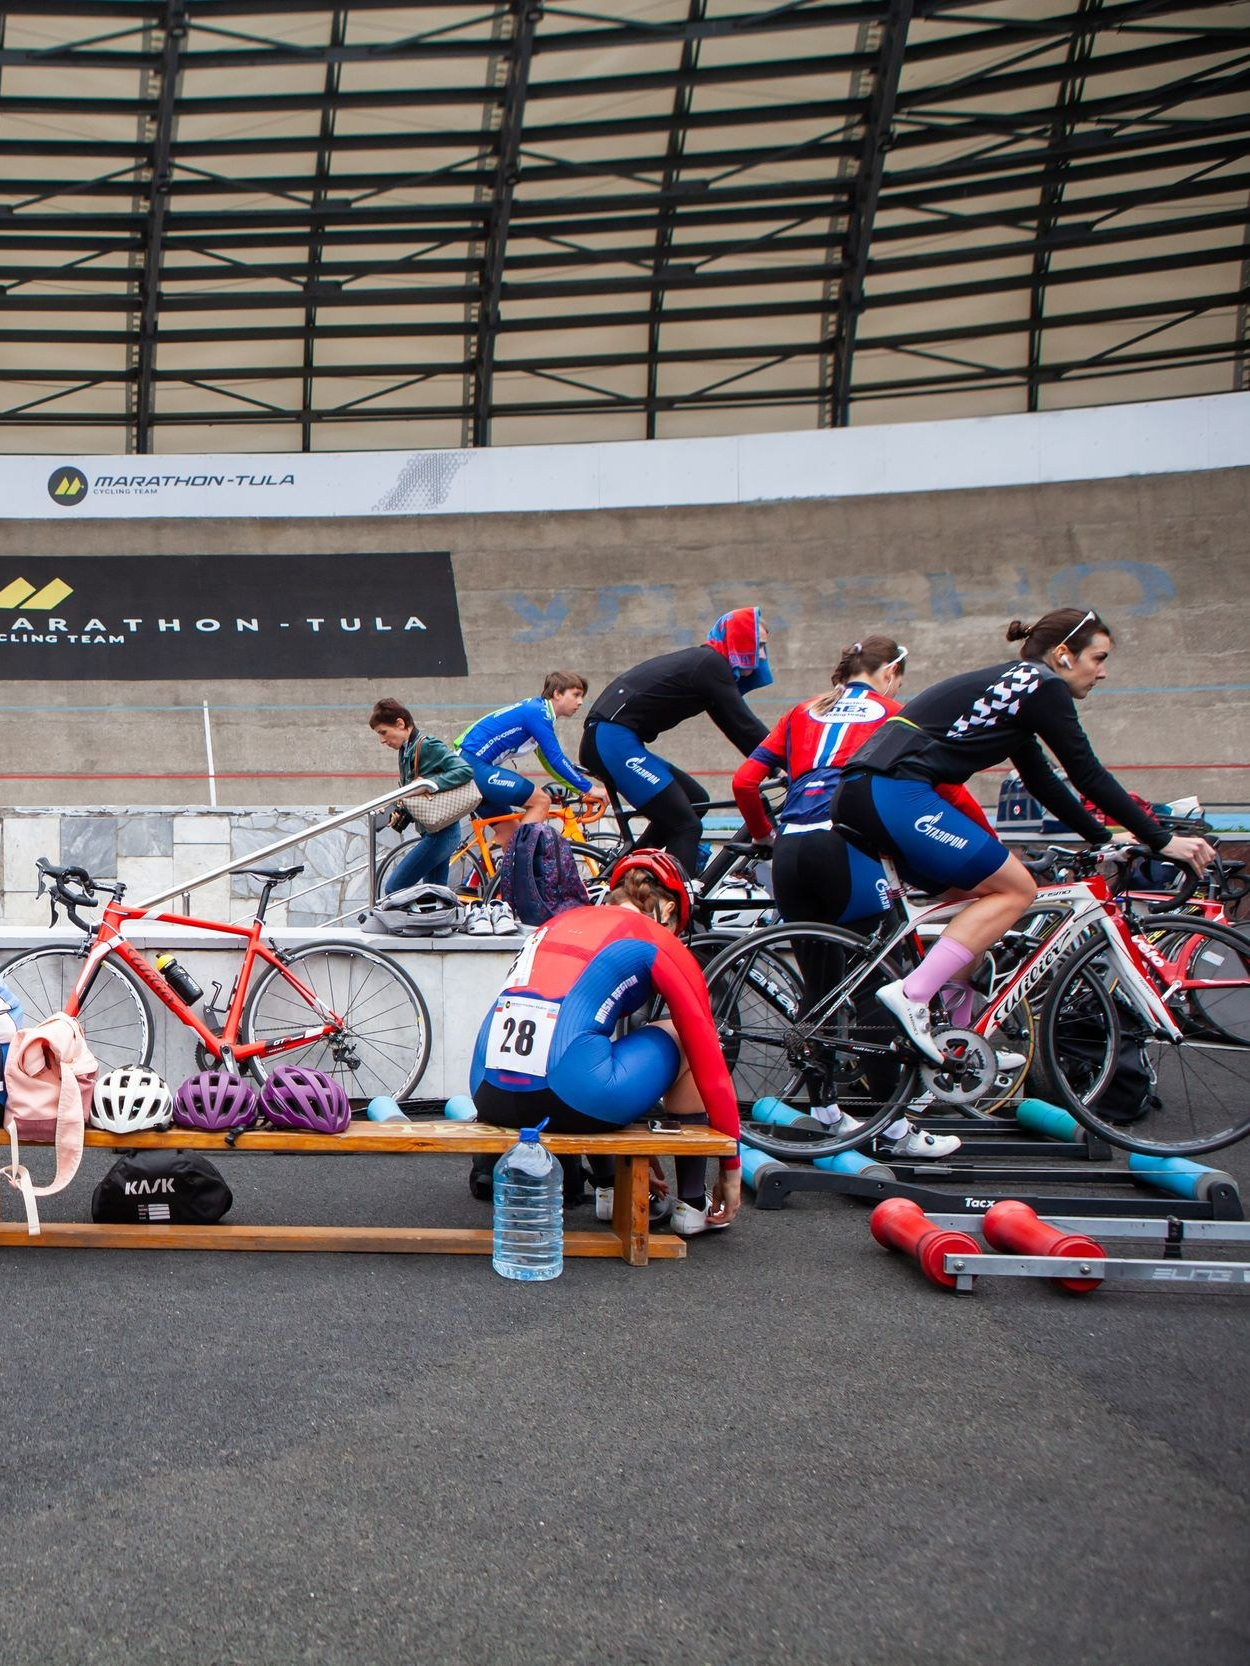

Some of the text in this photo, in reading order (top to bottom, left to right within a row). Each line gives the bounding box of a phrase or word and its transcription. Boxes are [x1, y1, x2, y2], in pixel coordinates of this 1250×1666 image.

[94, 474, 295, 487] MARATHON-TULA
[68, 635, 125, 644] TEAM
[926, 824, 969, 850] ГАЗПРОМ
[612, 975, 639, 1001] REGION
[500, 1017, 537, 1057] 28
[124, 1177, 176, 1195] KASK
[964, 1197, 996, 1209] Tacx
